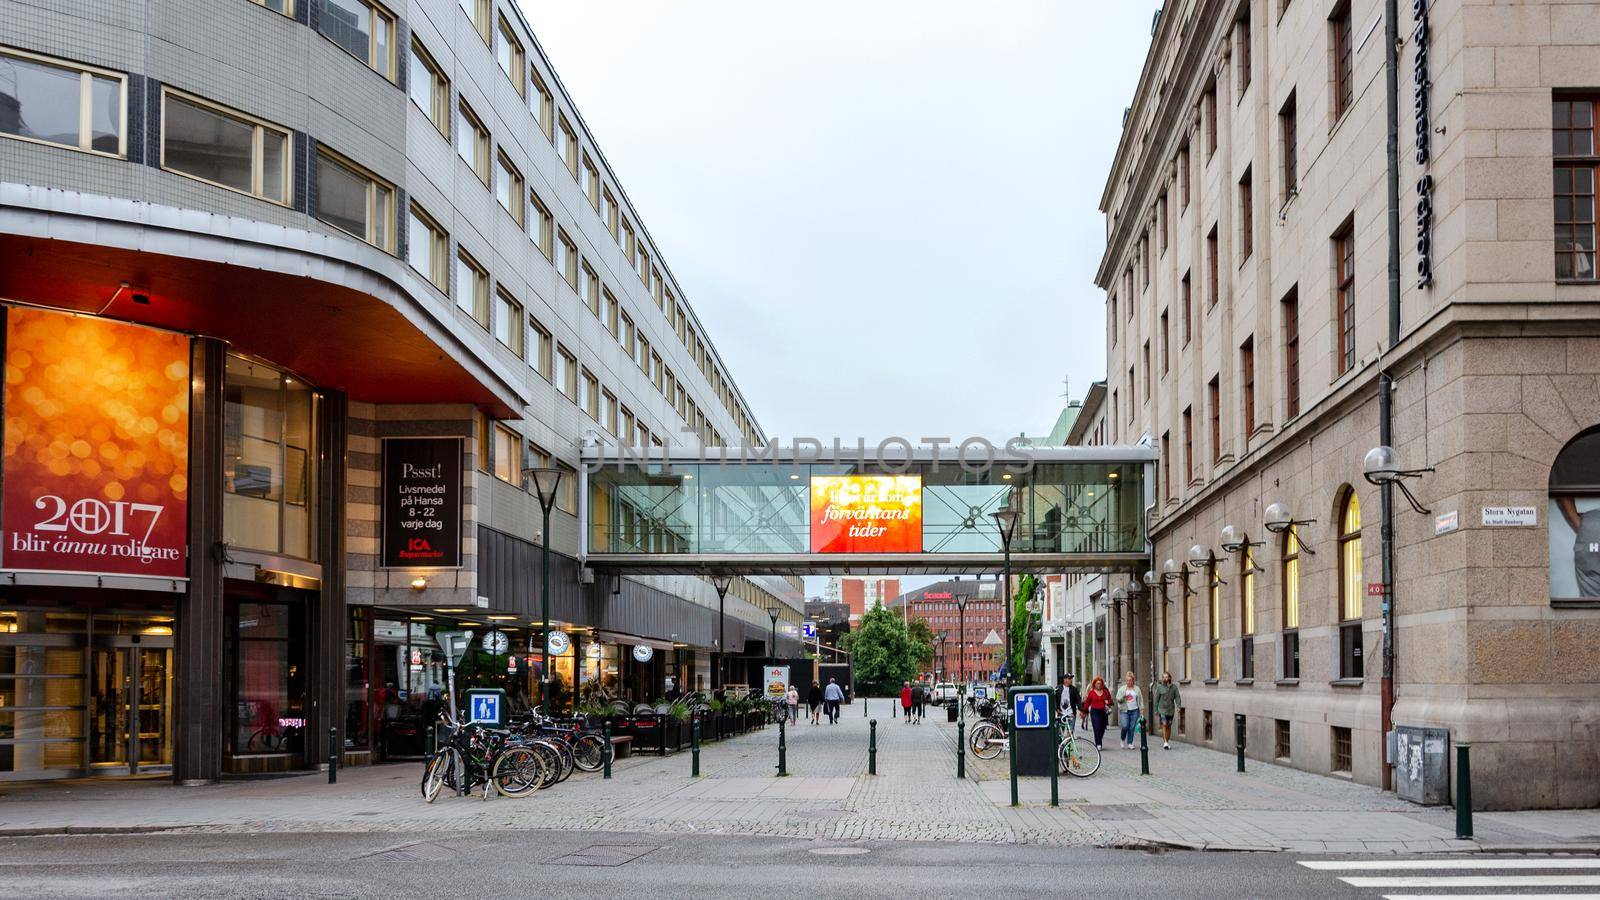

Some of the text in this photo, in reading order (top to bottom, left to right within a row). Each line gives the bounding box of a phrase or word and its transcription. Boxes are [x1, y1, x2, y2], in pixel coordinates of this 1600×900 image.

[1414, 15, 1429, 165] Business
[1416, 174, 1432, 289] School
[403, 463, 442, 478] Pssst!
[399, 484, 446, 494] Livsmedel
[401, 495, 444, 507] på Hansa
[409, 507, 416, 516] 8
[423, 507, 435, 516] 22
[1507, 508, 1534, 517] Nygatan
[34, 494, 164, 552] 2017
[401, 519, 443, 531] varje dag
[848, 522, 887, 538] tider
[12, 532, 180, 564] blir ännu roligare
[408, 538, 431, 551] ICA
